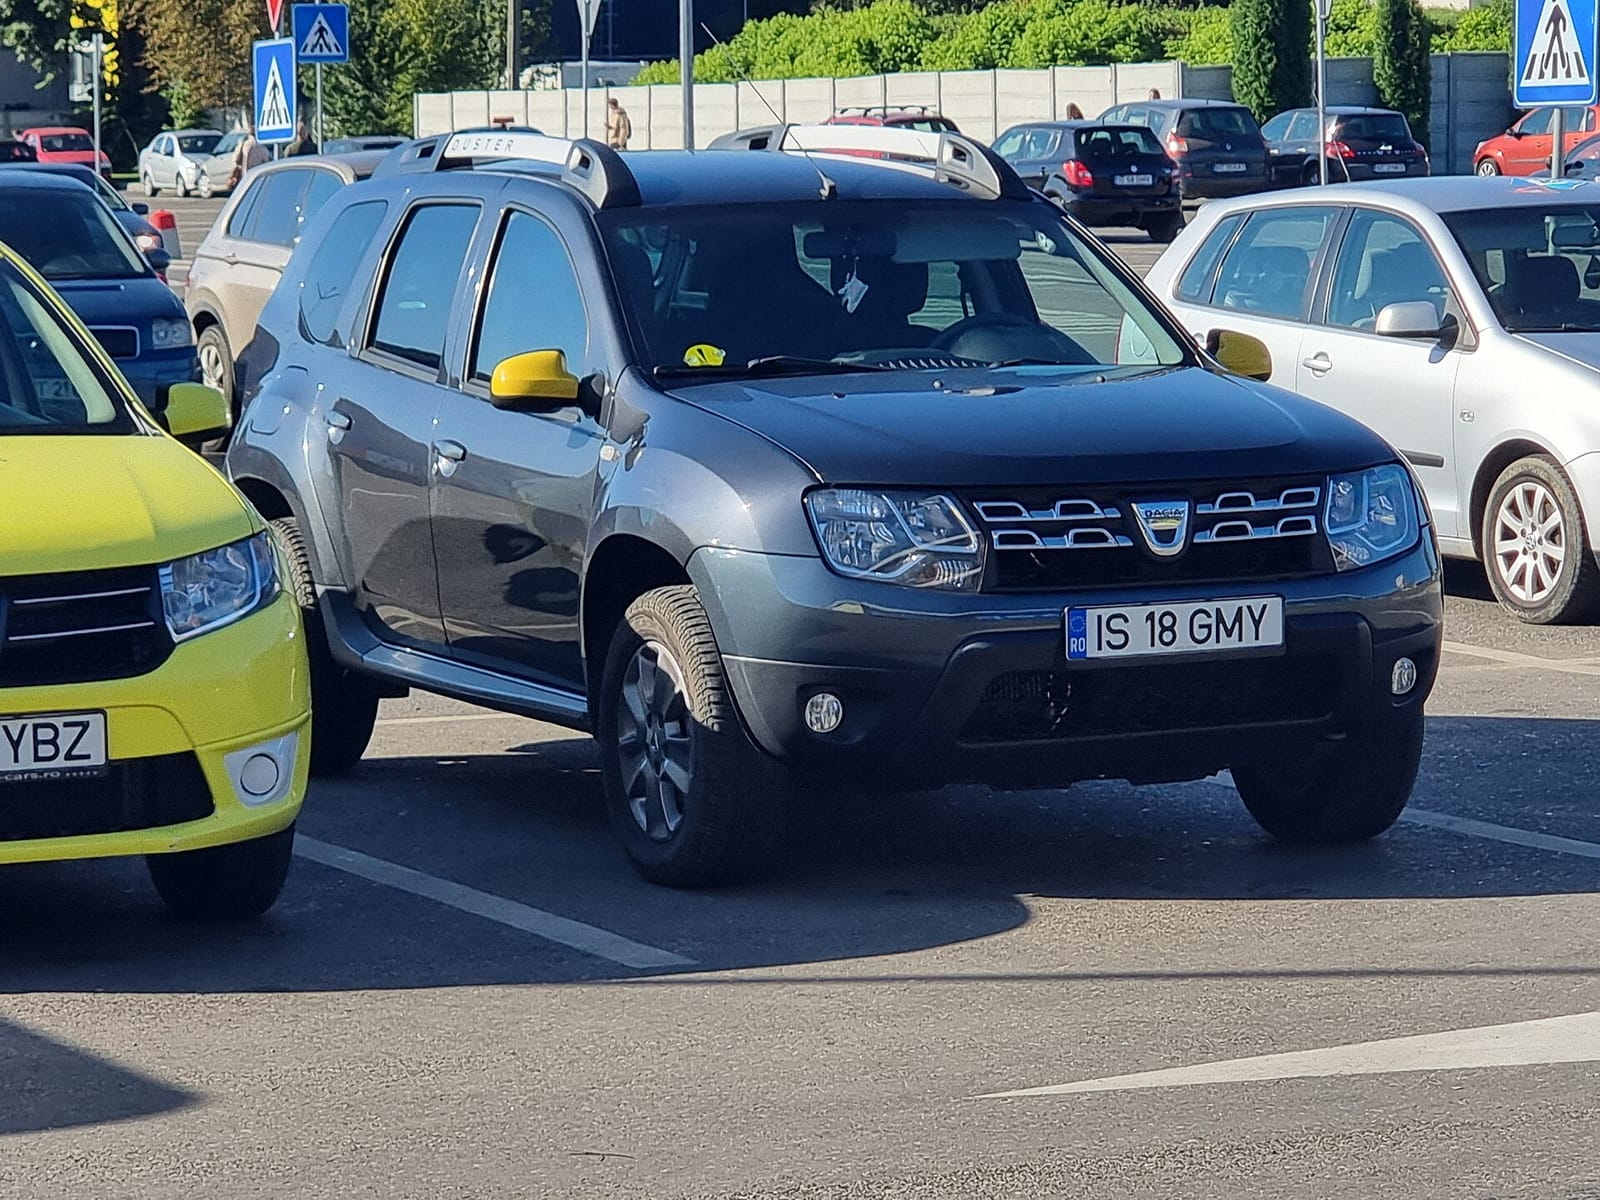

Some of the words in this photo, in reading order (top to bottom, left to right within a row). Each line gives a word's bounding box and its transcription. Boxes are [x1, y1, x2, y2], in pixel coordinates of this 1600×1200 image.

[452, 138, 515, 151] DUSTER
[1144, 508, 1182, 517] DACIA
[1096, 613, 1130, 651] IS
[1145, 610, 1178, 647] 18
[1189, 603, 1268, 645] GMY
[1070, 637, 1085, 653] RO
[2, 720, 91, 764] YBZ
